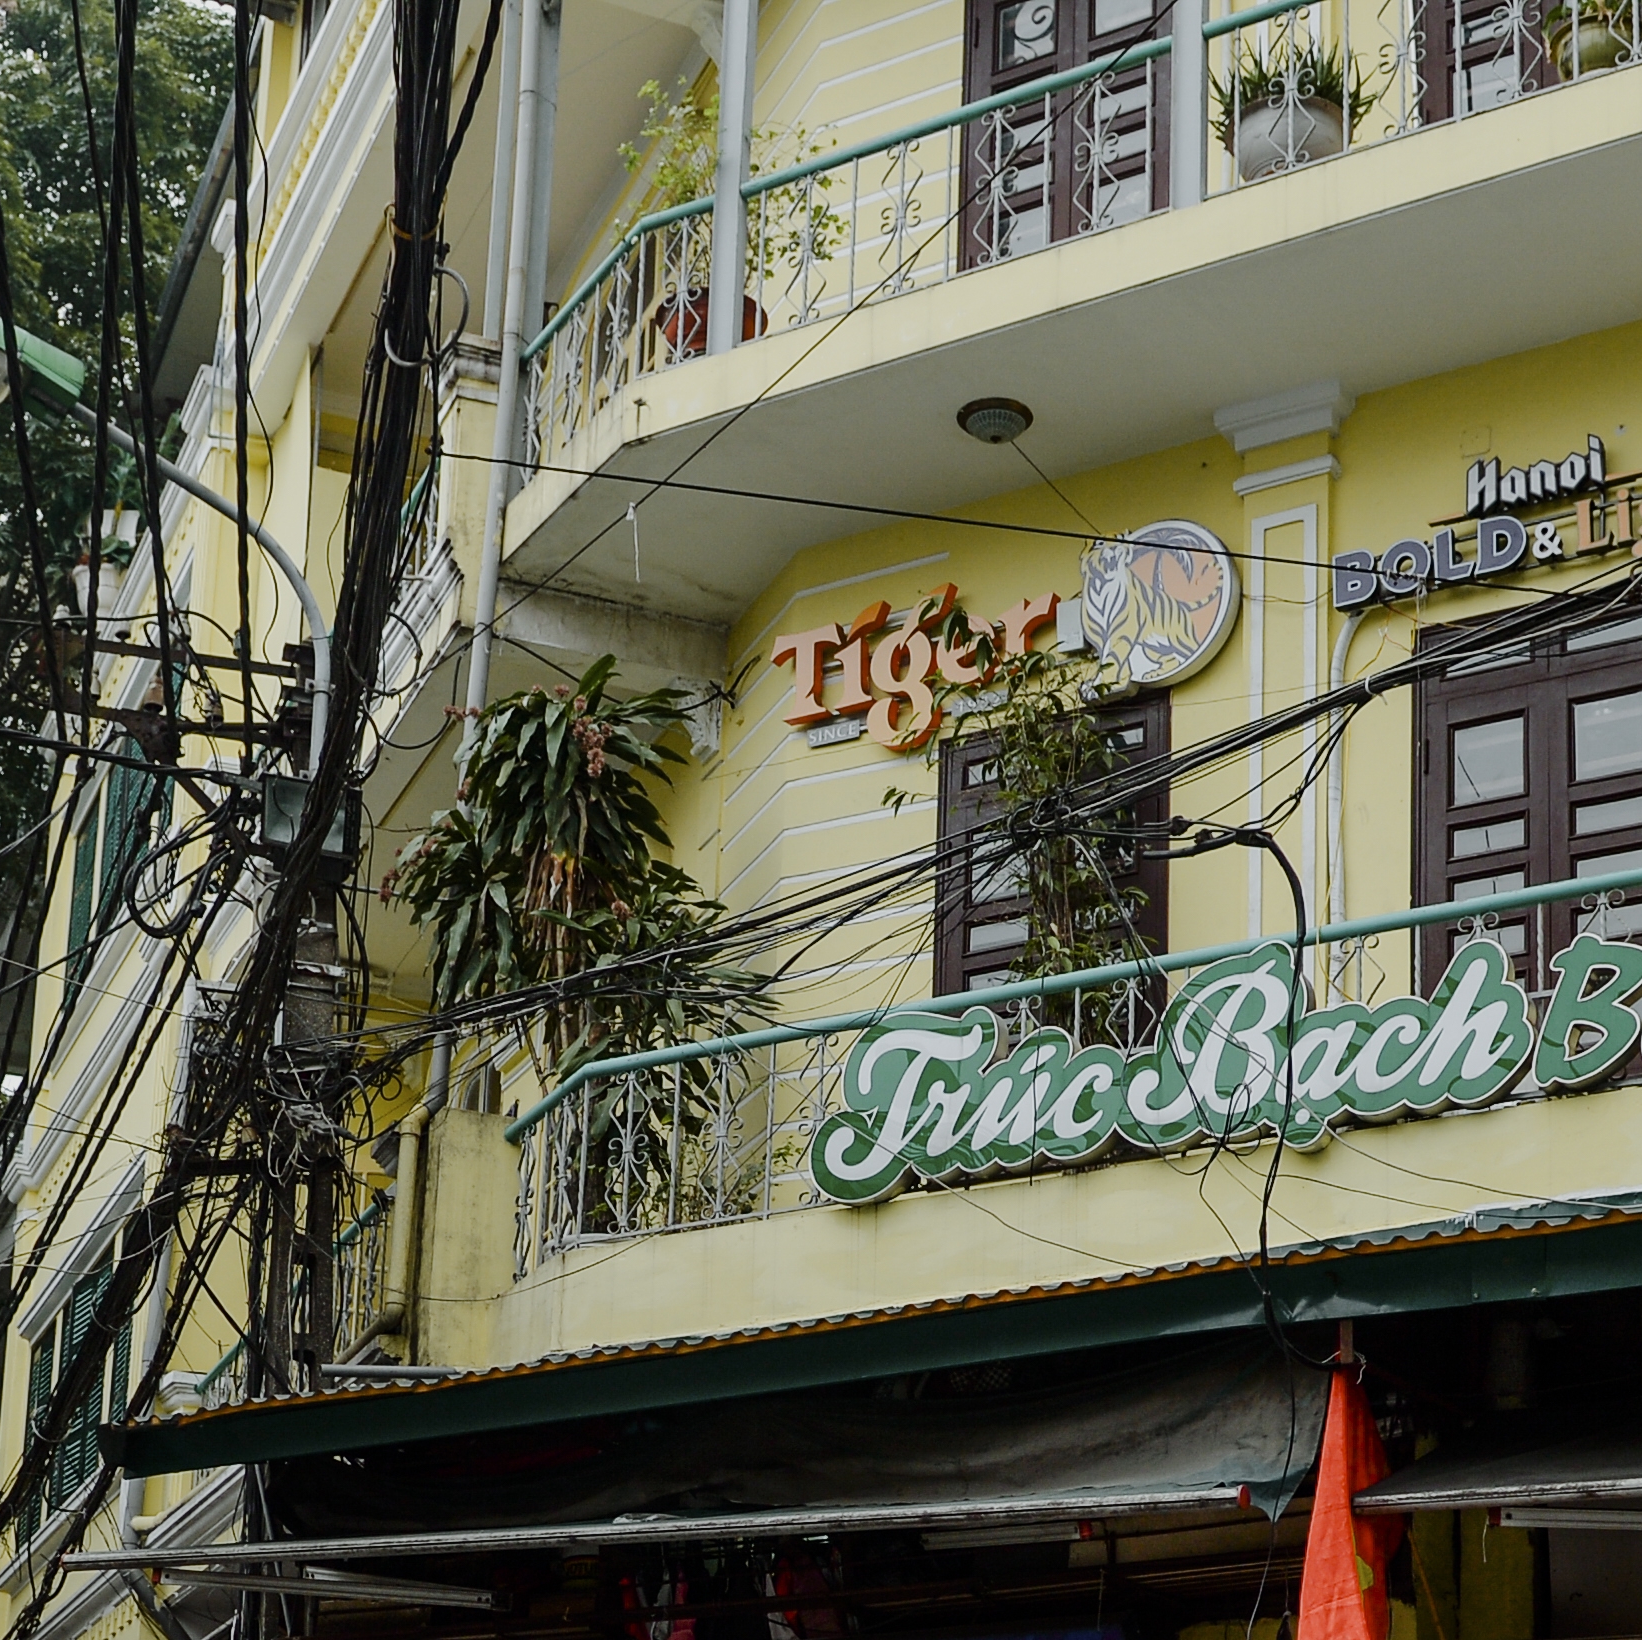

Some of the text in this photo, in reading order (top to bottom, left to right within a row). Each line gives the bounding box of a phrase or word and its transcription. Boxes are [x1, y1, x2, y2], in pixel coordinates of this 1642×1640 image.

[1466, 433, 1607, 516] Hanoi
[1332, 516, 1530, 612] BOLD
[1532, 521, 1562, 560] &
[770, 582, 1062, 751] Tiger
[808, 691, 1005, 748] SINCE 193
[814, 1008, 1119, 1192] Trúc
